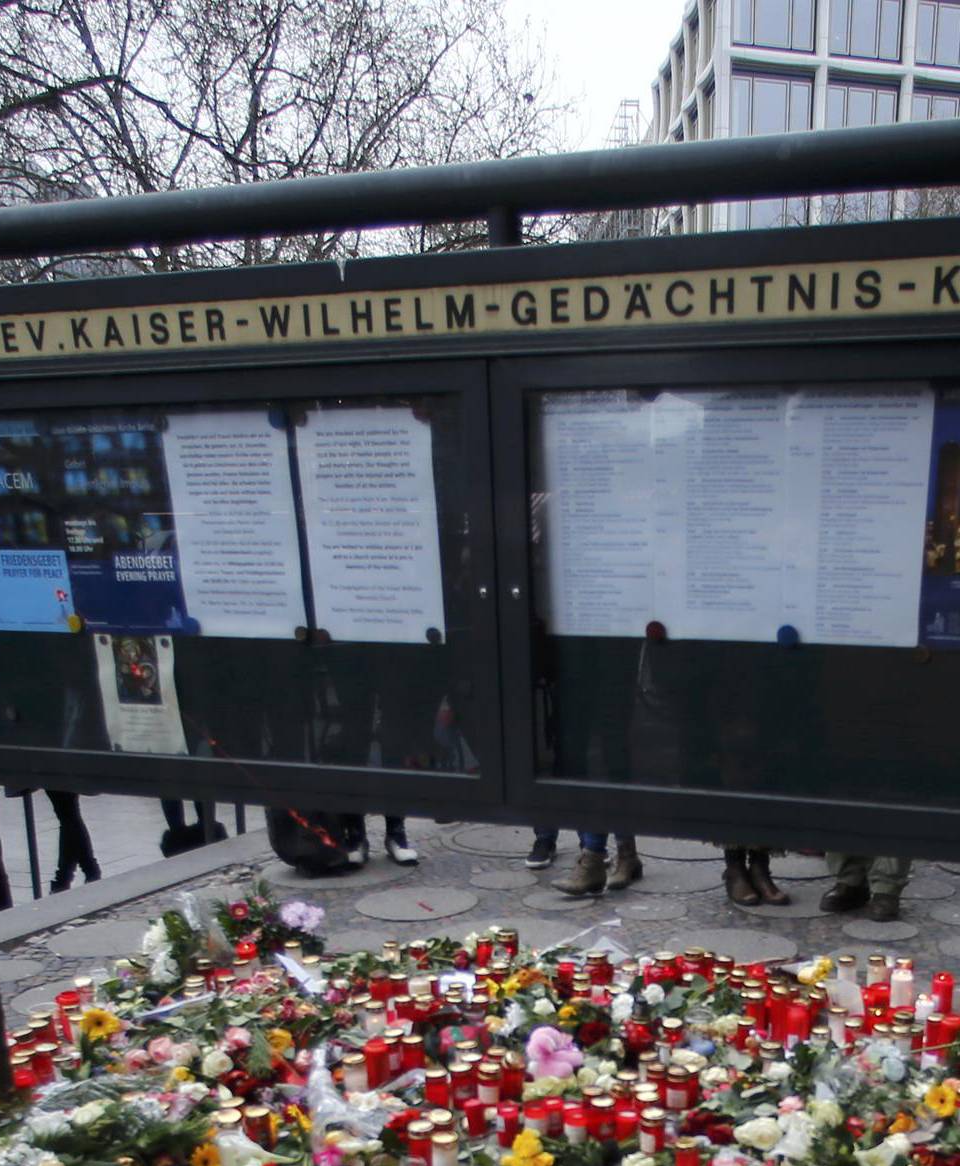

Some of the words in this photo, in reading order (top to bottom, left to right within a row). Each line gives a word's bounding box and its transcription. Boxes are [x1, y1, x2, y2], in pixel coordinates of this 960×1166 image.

[115, 555, 174, 569] ABENDGEBET
[116, 571, 146, 582] EVENING
[148, 571, 176, 582] PRAYER
